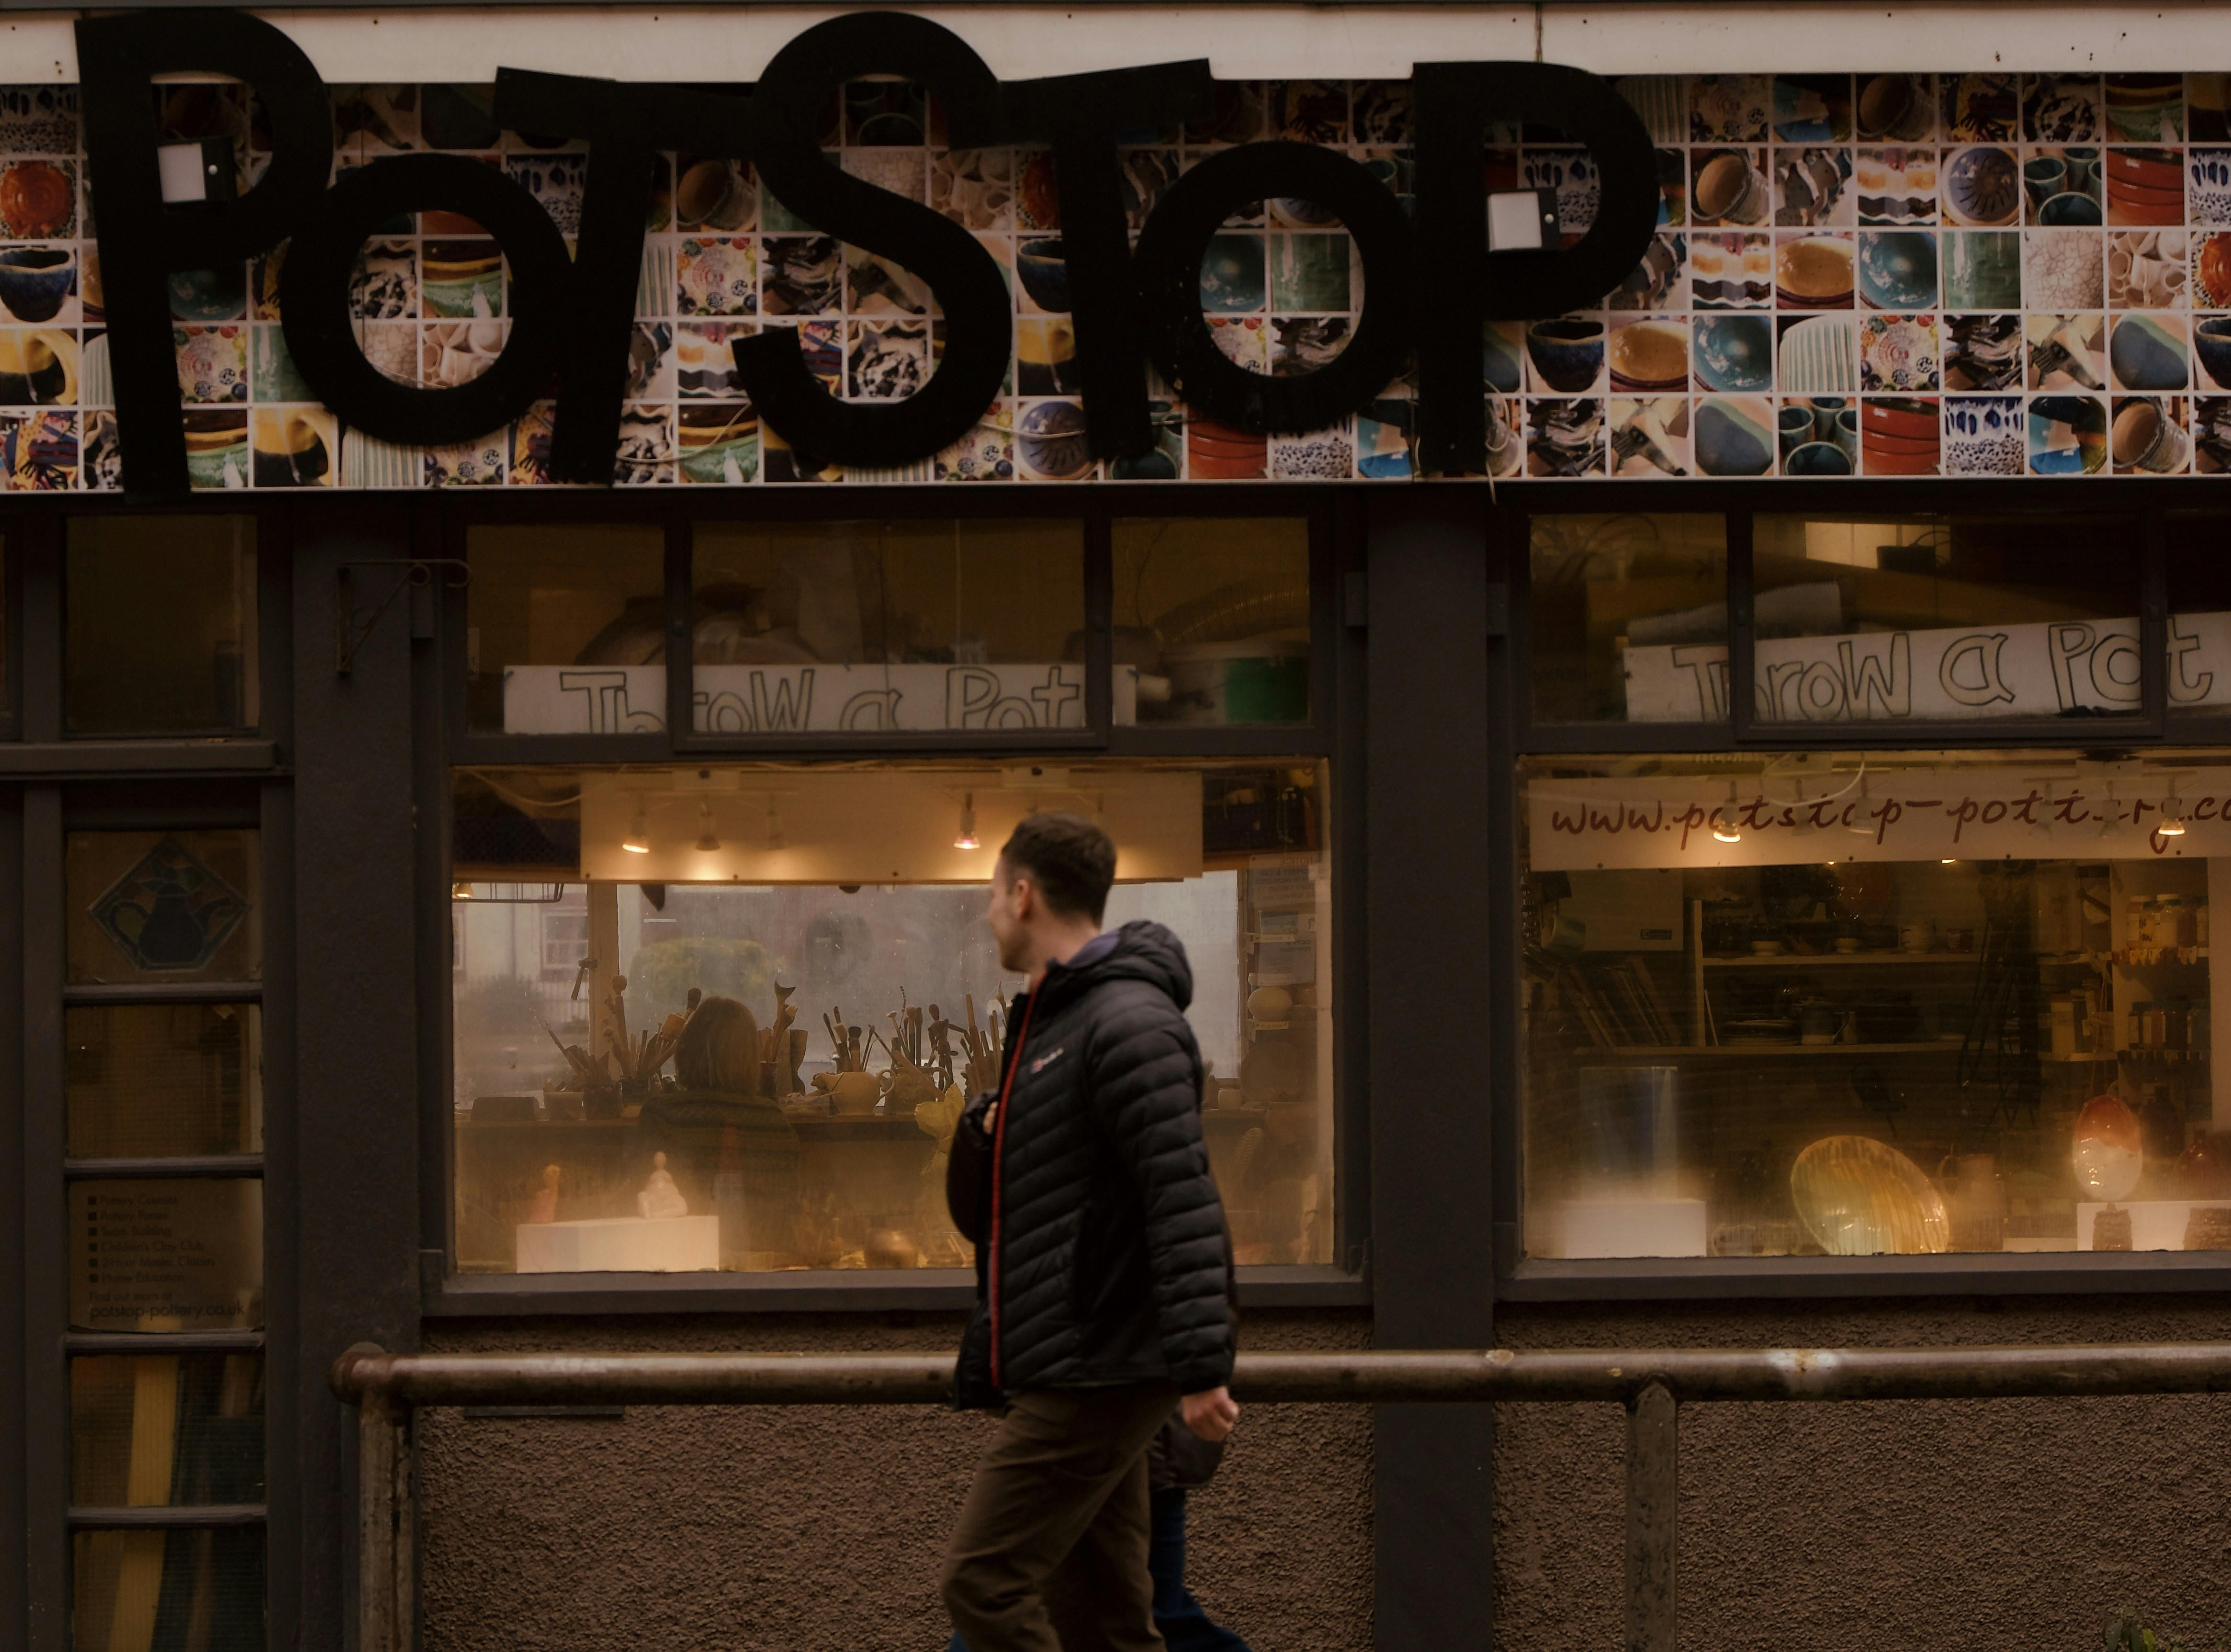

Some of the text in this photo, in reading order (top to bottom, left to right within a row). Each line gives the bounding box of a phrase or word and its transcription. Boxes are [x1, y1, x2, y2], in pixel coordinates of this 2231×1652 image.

[2048, 616, 2213, 711] Pot
[945, 665, 1081, 730] Pot
[100, 1193, 179, 1207] Pottery Courses
[101, 1211, 134, 1222] Pottery
[131, 1225, 172, 1238] Building
[152, 1241, 177, 1253] Clay
[180, 1240, 205, 1251] Club
[139, 1257, 174, 1268] Master
[135, 1272, 184, 1283] Education
[113, 1292, 130, 1301] out
[161, 1291, 172, 1300] at
[90, 1300, 245, 1321] potstop-pottery.co.uk
